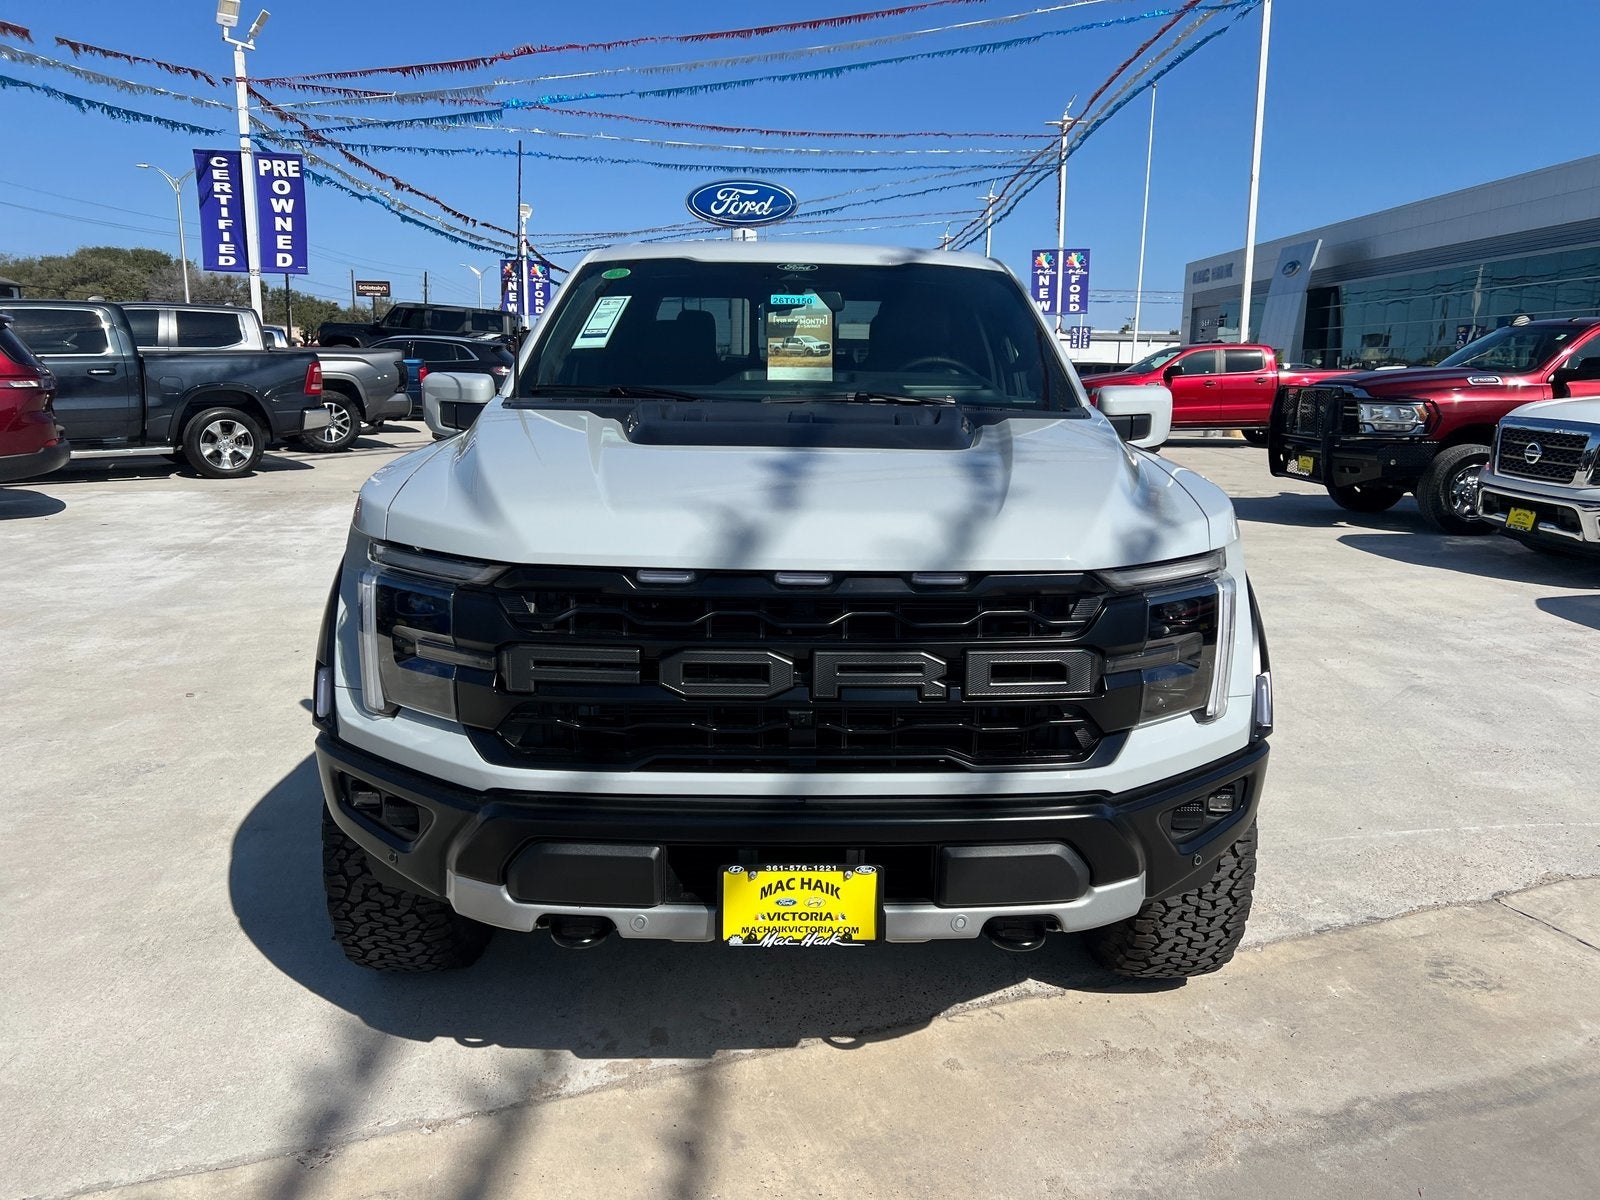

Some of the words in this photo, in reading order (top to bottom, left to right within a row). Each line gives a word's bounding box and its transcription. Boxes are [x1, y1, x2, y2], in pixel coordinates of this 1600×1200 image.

[258, 159, 300, 178] PRE
[209, 156, 236, 266] CERTIFIED
[710, 187, 775, 216] Ford
[270, 180, 294, 267] OWNED
[506, 281, 518, 313] NEW
[534, 282, 545, 314] FORD
[773, 297, 813, 305] 26T0150
[1036, 275, 1051, 312] NEW
[1069, 275, 1081, 312] FORD
[501, 643, 1101, 700] FORD
[760, 877, 796, 900] MAC
[800, 877, 841, 900] HAIK
[741, 925, 860, 935] MACHAIKVICTORIA.COM
[767, 912, 834, 922] VICTORIA
[759, 931, 799, 948] Mac
[800, 931, 844, 948] Haik
